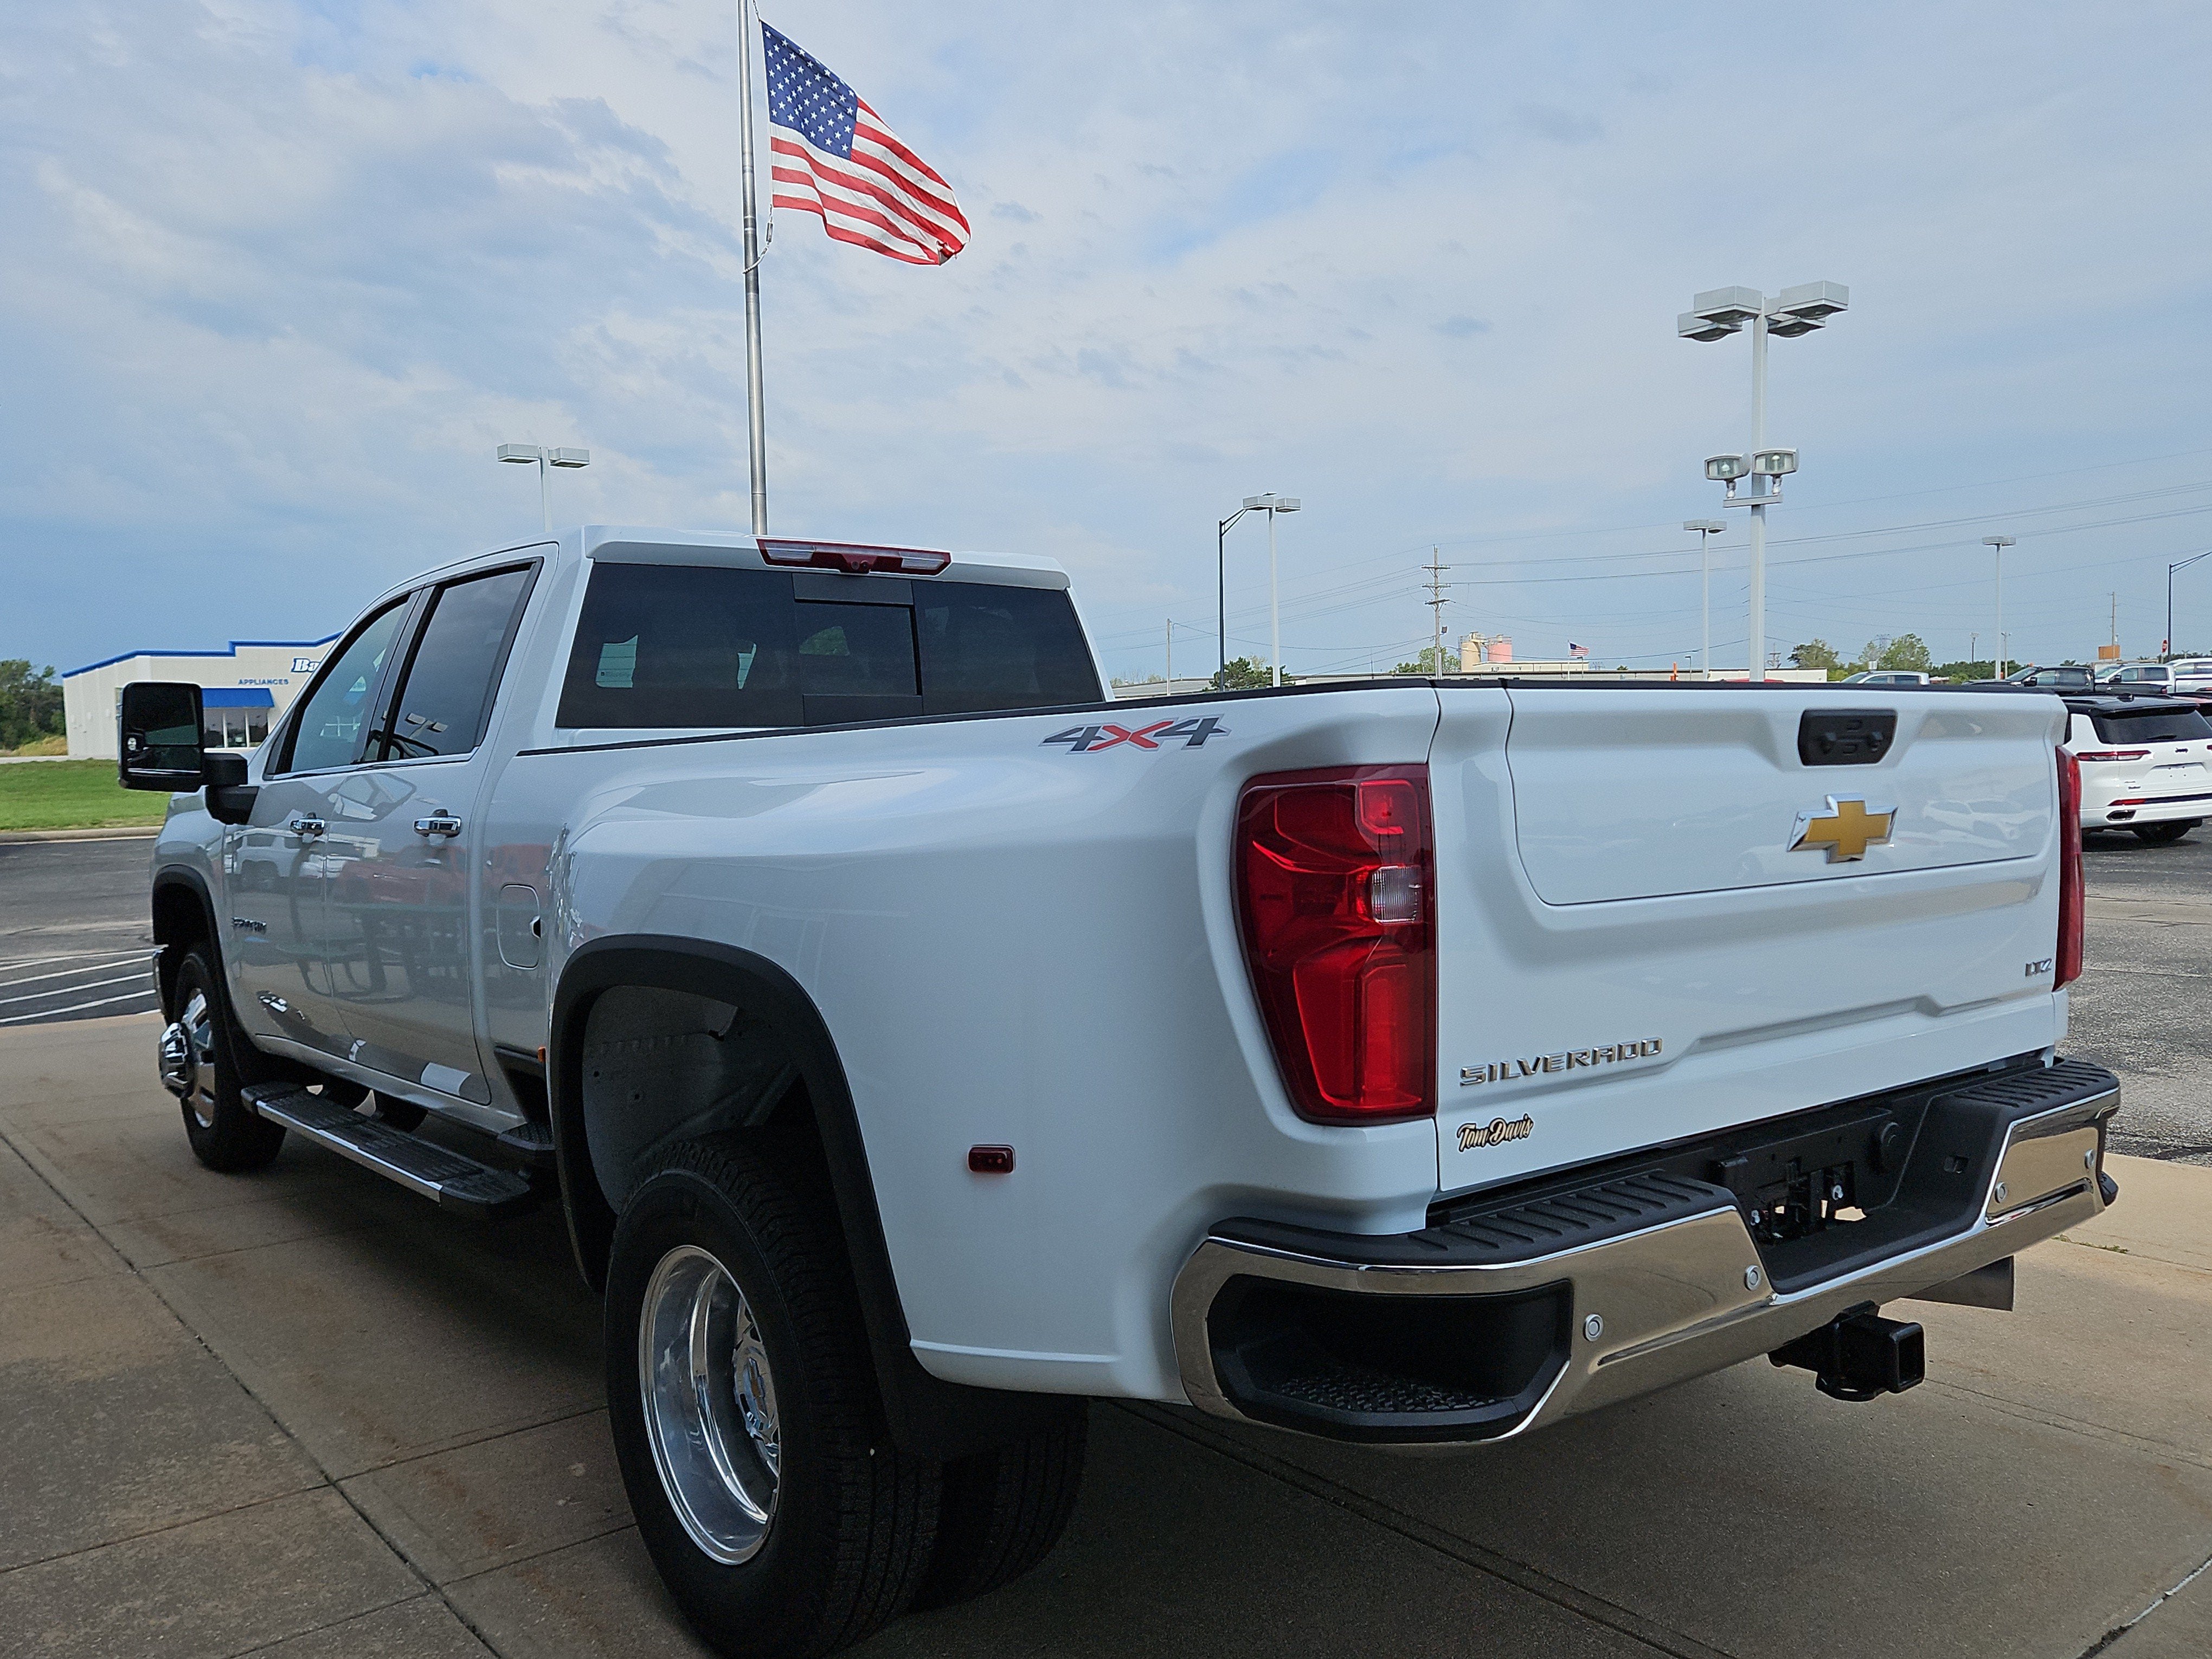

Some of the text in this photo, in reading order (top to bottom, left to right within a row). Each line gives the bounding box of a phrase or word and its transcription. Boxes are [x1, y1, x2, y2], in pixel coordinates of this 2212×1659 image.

[1459, 1036, 1663, 1087] SILVERADO
[1457, 1113, 1534, 1153] Tom Davis
